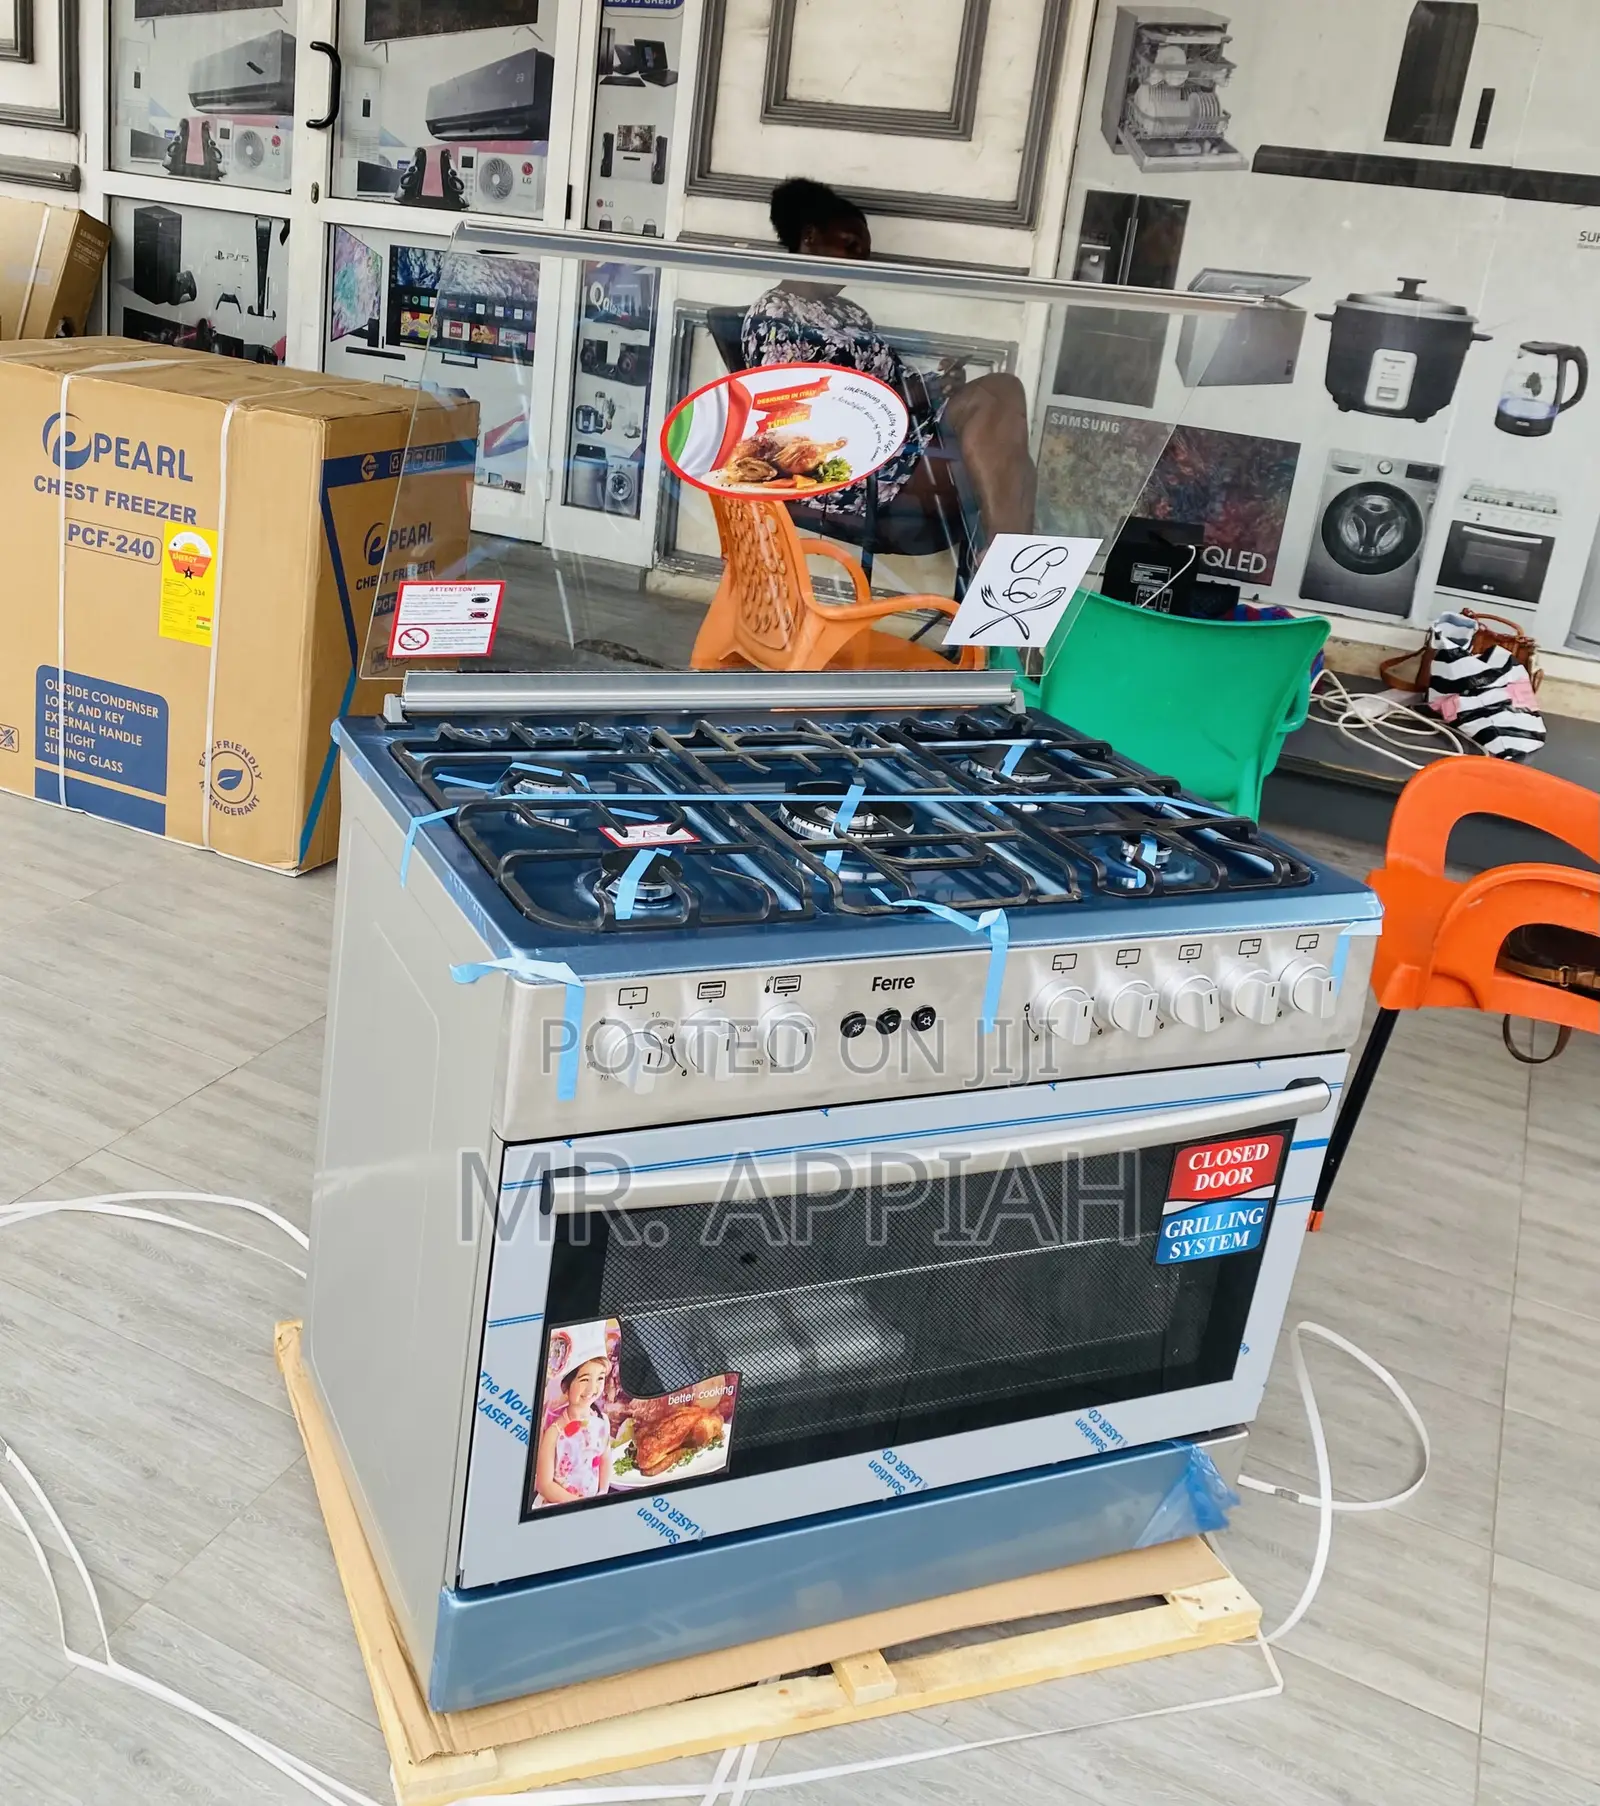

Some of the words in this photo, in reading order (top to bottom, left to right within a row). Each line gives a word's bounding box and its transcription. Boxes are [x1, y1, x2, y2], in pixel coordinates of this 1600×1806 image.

[271, 147, 281, 156] LG
[521, 176, 533, 185] LG
[604, 200, 614, 208] LG
[1050, 412, 1121, 434] SAMSUNG
[93, 432, 194, 482] PEARL
[33, 474, 99, 503] CHEST
[104, 489, 197, 525] FREEZER
[67, 523, 155, 560] PCF-240
[388, 520, 434, 553] PEARL
[1202, 545, 1268, 574] QLED
[45, 679, 89, 700] OUTSIDE
[91, 691, 159, 719] CONDENSER
[45, 694, 74, 712] LOCK
[77, 703, 102, 719] AND
[104, 709, 125, 725] KEY
[45, 710, 96, 734] EXERNAL
[99, 725, 143, 747] HANDLE
[66, 733, 96, 749] LIGHT
[89, 754, 123, 774] GLASS
[871, 975, 916, 992] Ferre
[1188, 1142, 1270, 1171] CLOSED
[1193, 1166, 1254, 1192] DOOR
[1164, 1206, 1265, 1240] GRILLING
[1169, 1229, 1252, 1260] SYSTEM
[480, 1370, 500, 1395] The
[667, 1392, 696, 1406] better
[698, 1384, 735, 1400] cooking
[477, 1397, 514, 1430] LASER
[1075, 1418, 1108, 1452] Solution
[1098, 1419, 1124, 1446] LASER
[868, 1460, 906, 1496] Solution
[895, 1460, 923, 1488] LASER
[636, 1507, 681, 1544] Solution
[667, 1508, 700, 1536] LASER
